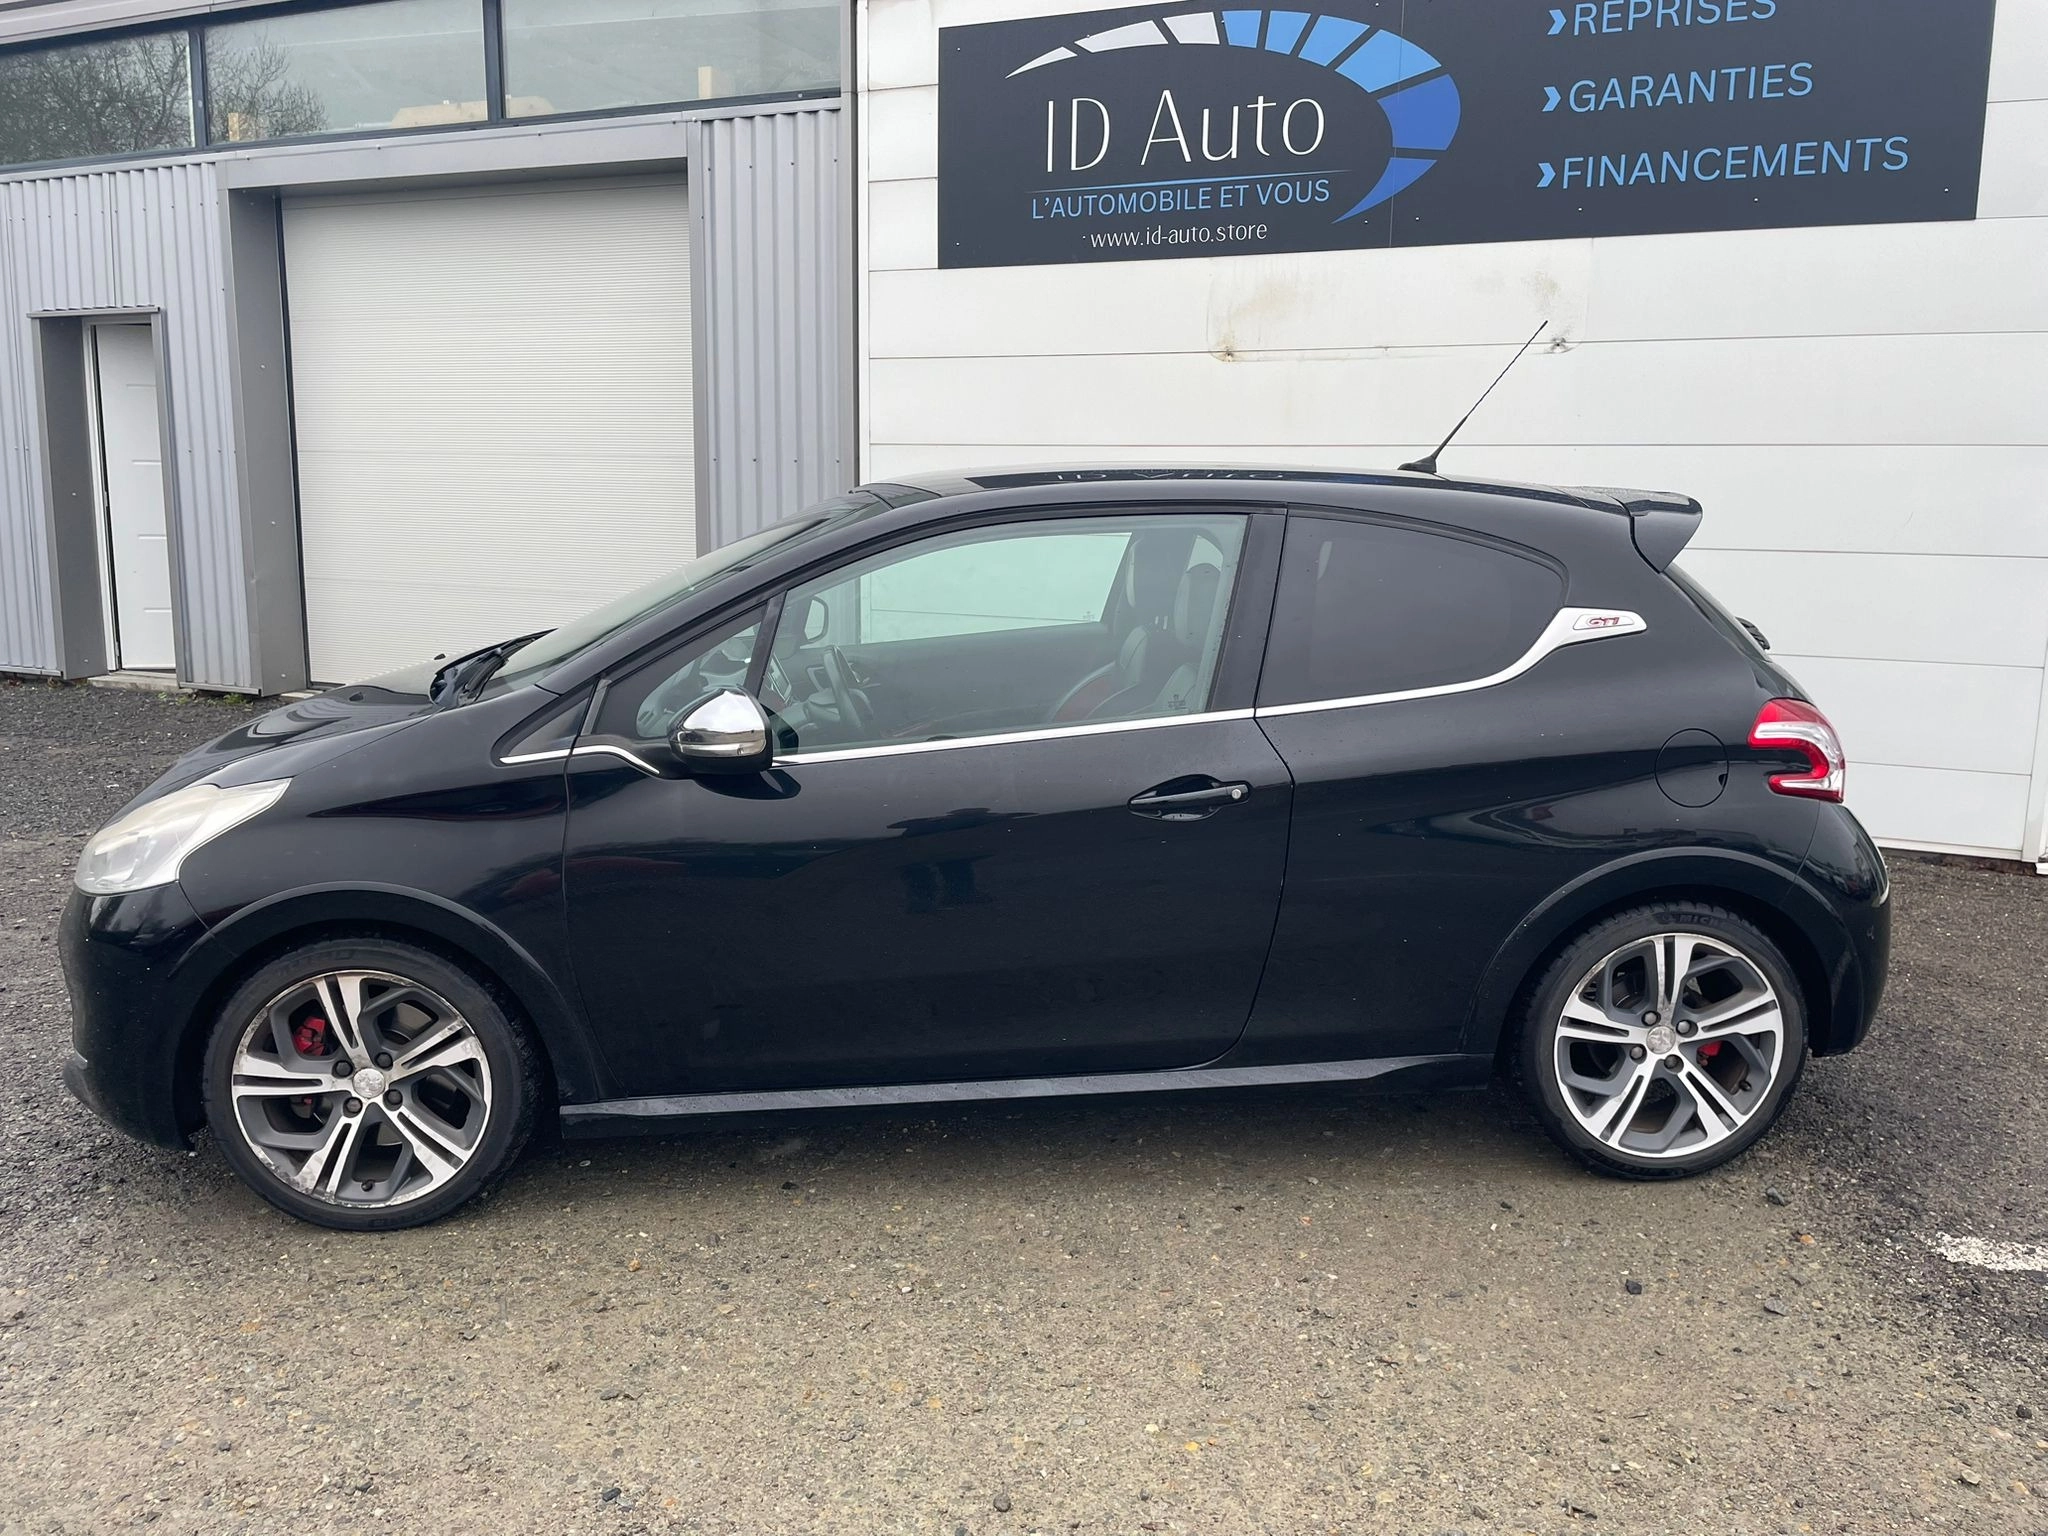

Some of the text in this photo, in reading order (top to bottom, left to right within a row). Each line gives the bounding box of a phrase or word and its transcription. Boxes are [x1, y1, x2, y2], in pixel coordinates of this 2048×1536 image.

[1573, 0, 1777, 37] REPRISES
[1568, 61, 1814, 113] GARANTIES
[1046, 89, 1326, 173] ID Auto
[1562, 135, 1910, 190] FINANCEMENTS
[1031, 178, 1331, 220] L'AUTOMOBILE ET VOUS
[1090, 222, 1268, 248] www.id-auto.store
